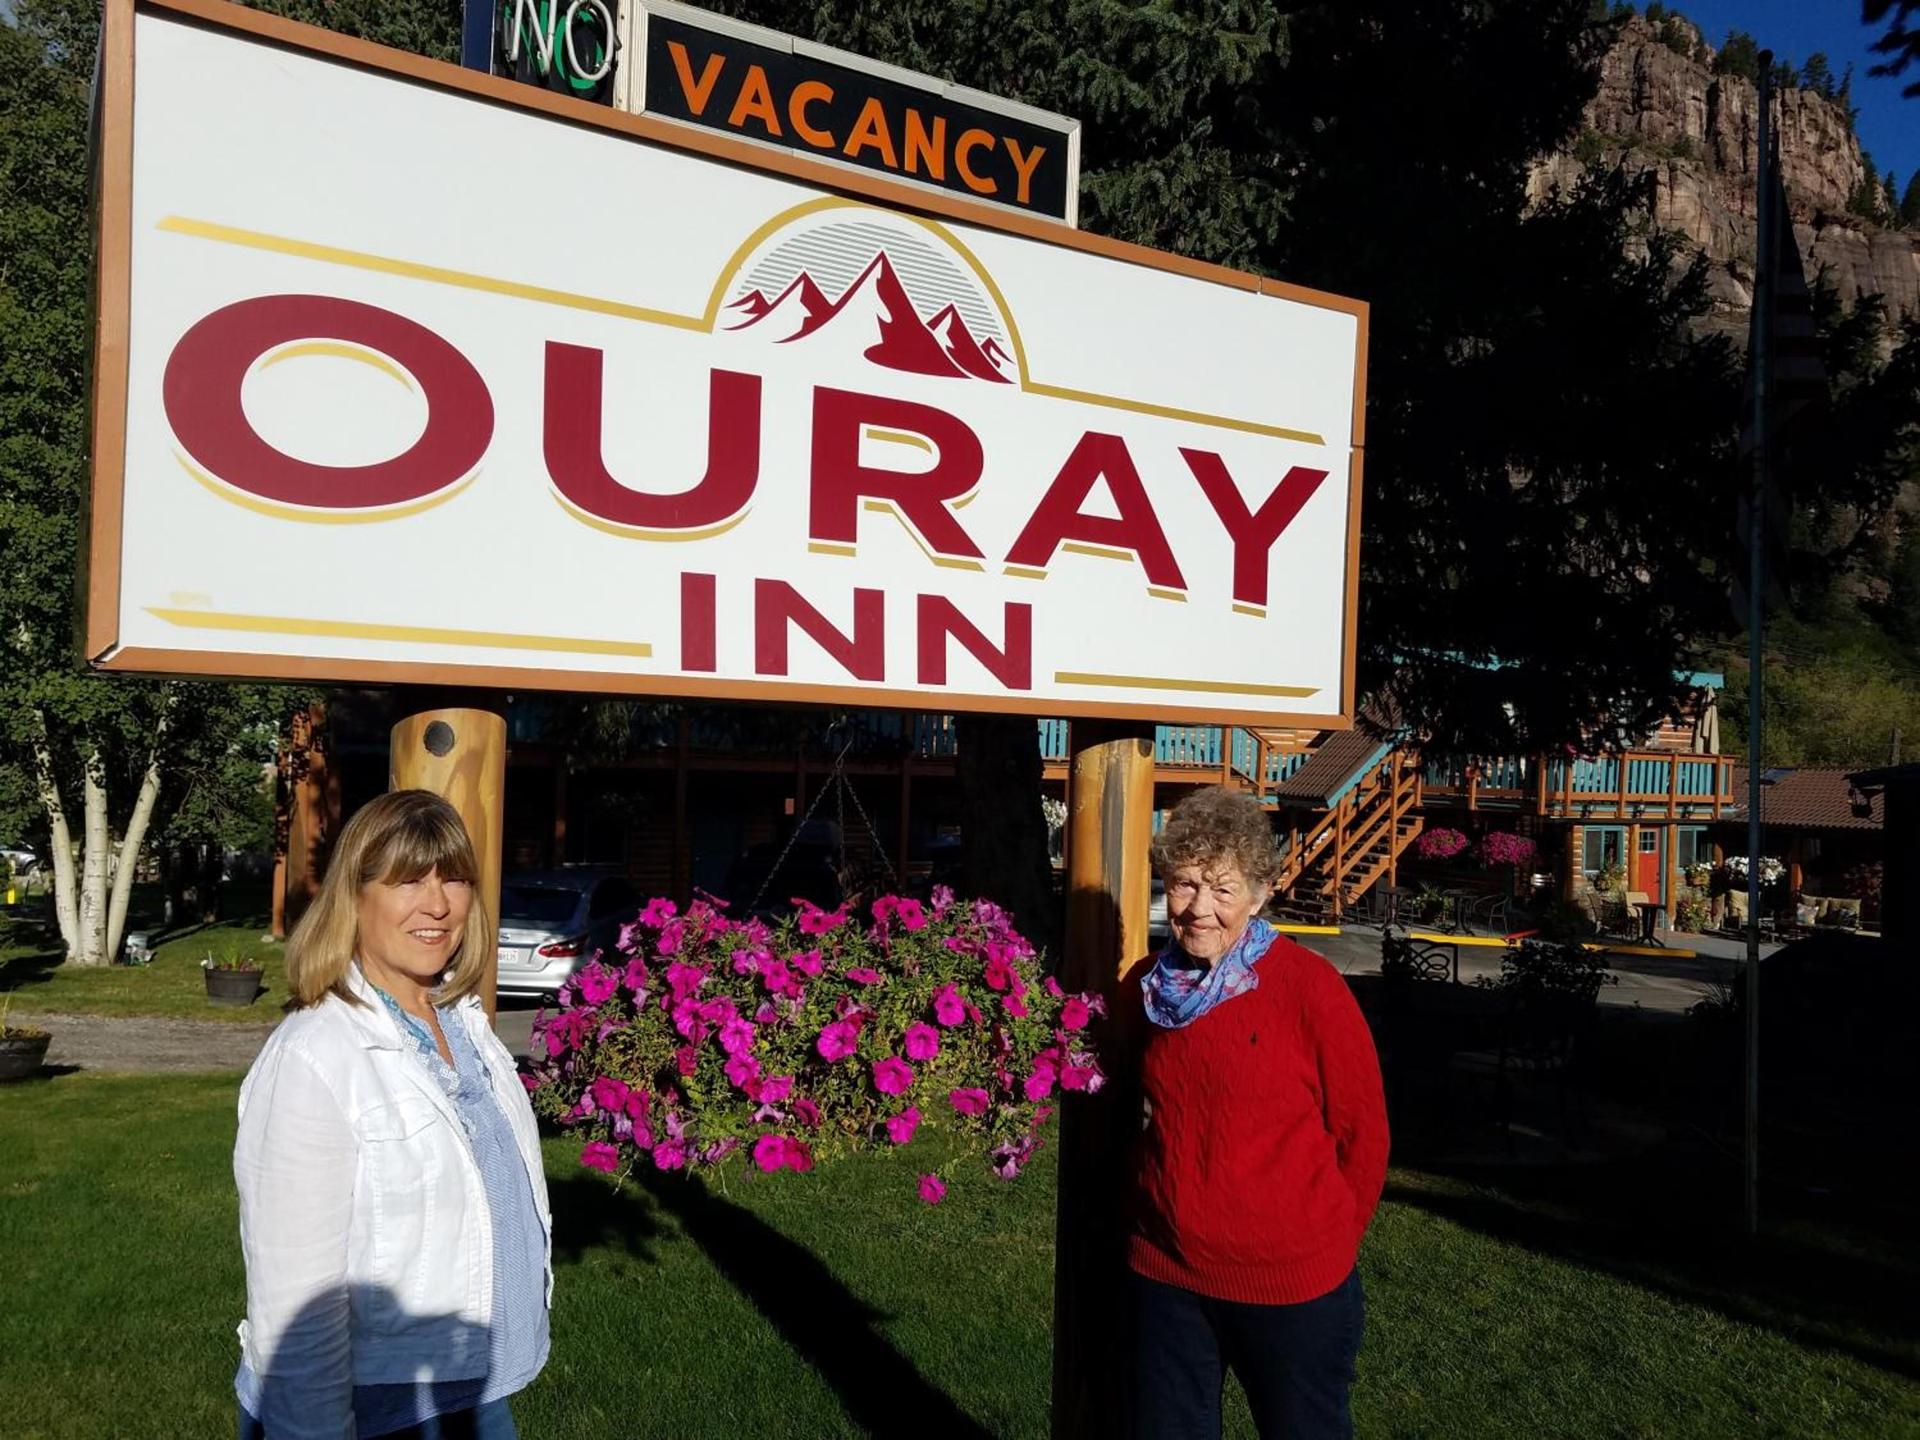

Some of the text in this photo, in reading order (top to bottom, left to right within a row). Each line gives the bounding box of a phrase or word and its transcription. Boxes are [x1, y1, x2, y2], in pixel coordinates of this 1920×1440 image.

[507, 0, 1047, 204] NO VACANCY
[164, 294, 1328, 607] OURAY
[681, 572, 1032, 690] INN
